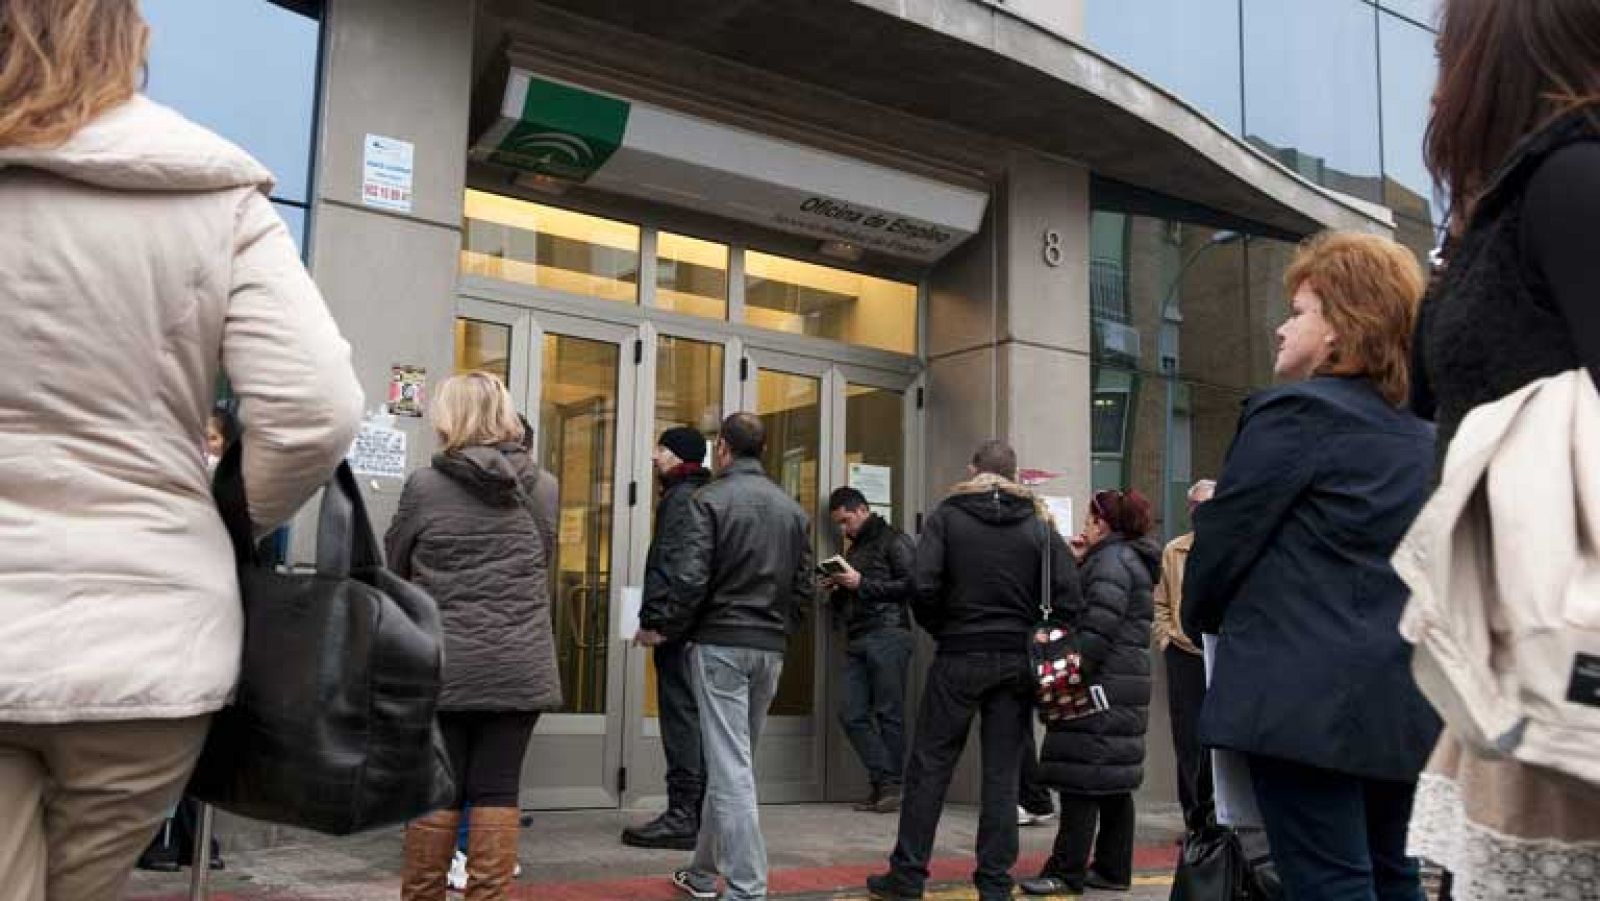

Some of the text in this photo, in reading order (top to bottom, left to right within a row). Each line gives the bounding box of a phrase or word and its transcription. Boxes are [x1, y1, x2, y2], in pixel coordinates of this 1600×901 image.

[800, 197, 864, 222] Oficina
[863, 213, 888, 228] de
[886, 218, 950, 243] Empleo
[1043, 230, 1062, 268] 8
